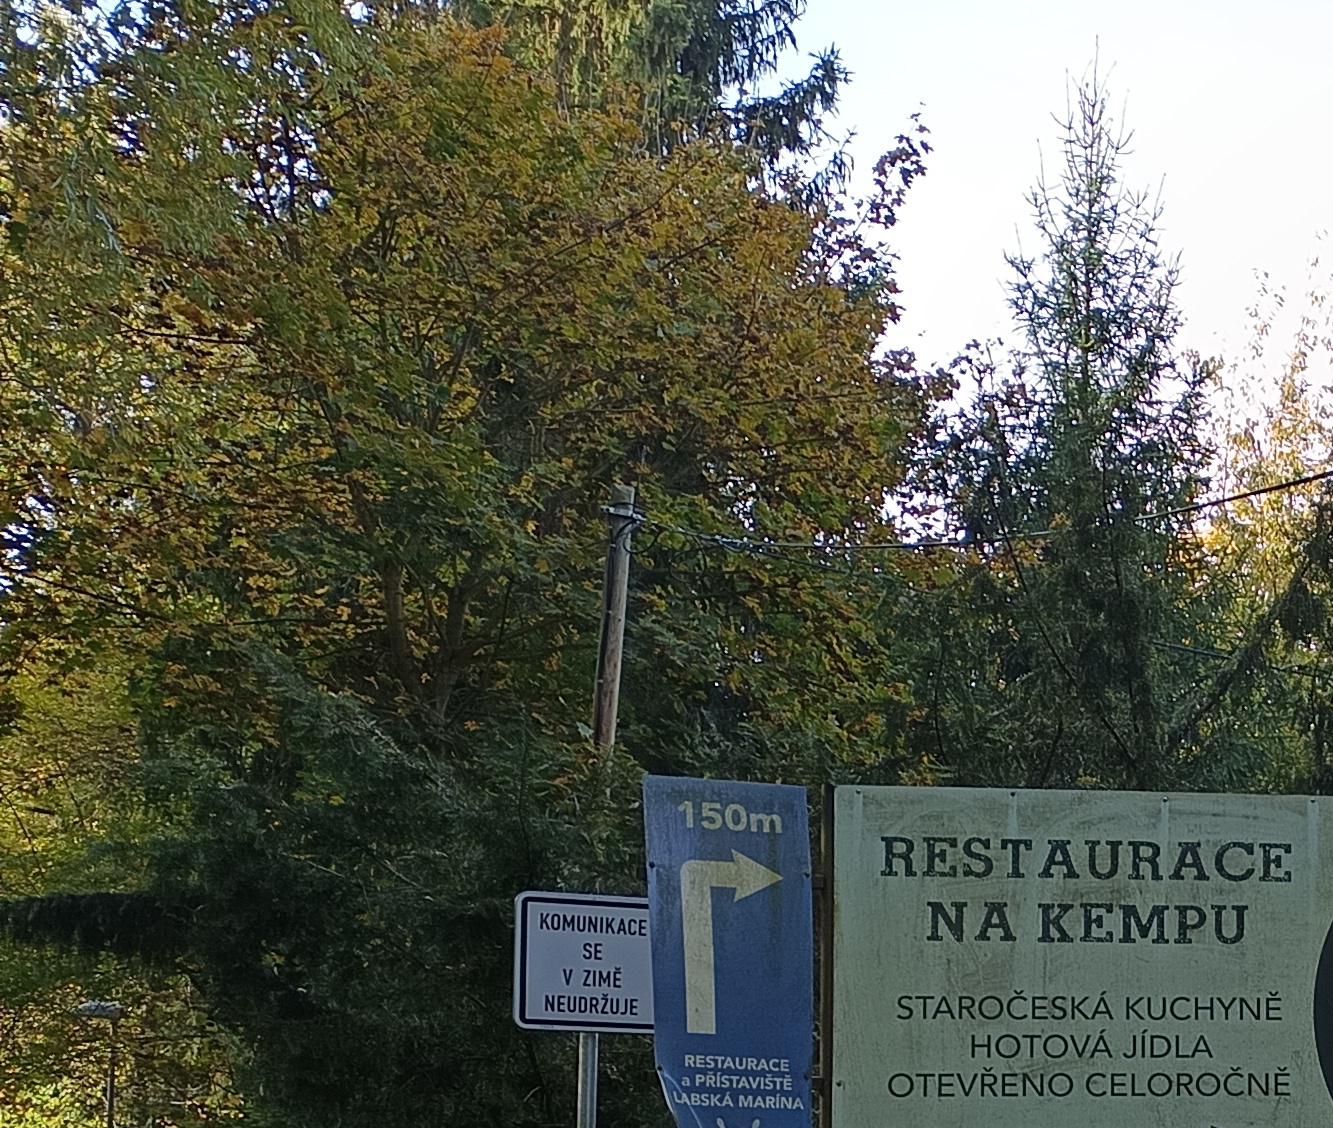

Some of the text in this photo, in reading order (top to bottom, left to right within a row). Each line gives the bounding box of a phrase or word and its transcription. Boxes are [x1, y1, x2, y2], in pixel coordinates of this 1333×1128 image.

[678, 801, 783, 834] 150m
[880, 836, 1292, 883] RESTAURACE
[539, 913, 647, 936] KOMUNIKACE
[926, 901, 1249, 945] NA KEMPU
[582, 943, 603, 960] SE
[562, 967, 622, 988] V ZIMĚ
[545, 994, 638, 1016] NEUDRŽUJE
[896, 990, 1283, 1021] STAROČESKÁ KUCHYNĚ
[970, 1029, 1213, 1059] HOTOVÁ JÍDLA
[685, 1054, 789, 1072] RESTAURACE
[681, 1071, 792, 1090] a PŘÍSTAVIŠTĚ
[887, 1067, 1292, 1098] OTEVŘENO CELOROČNĚ
[673, 1091, 804, 1110] LABSKÁ MARÍNA
